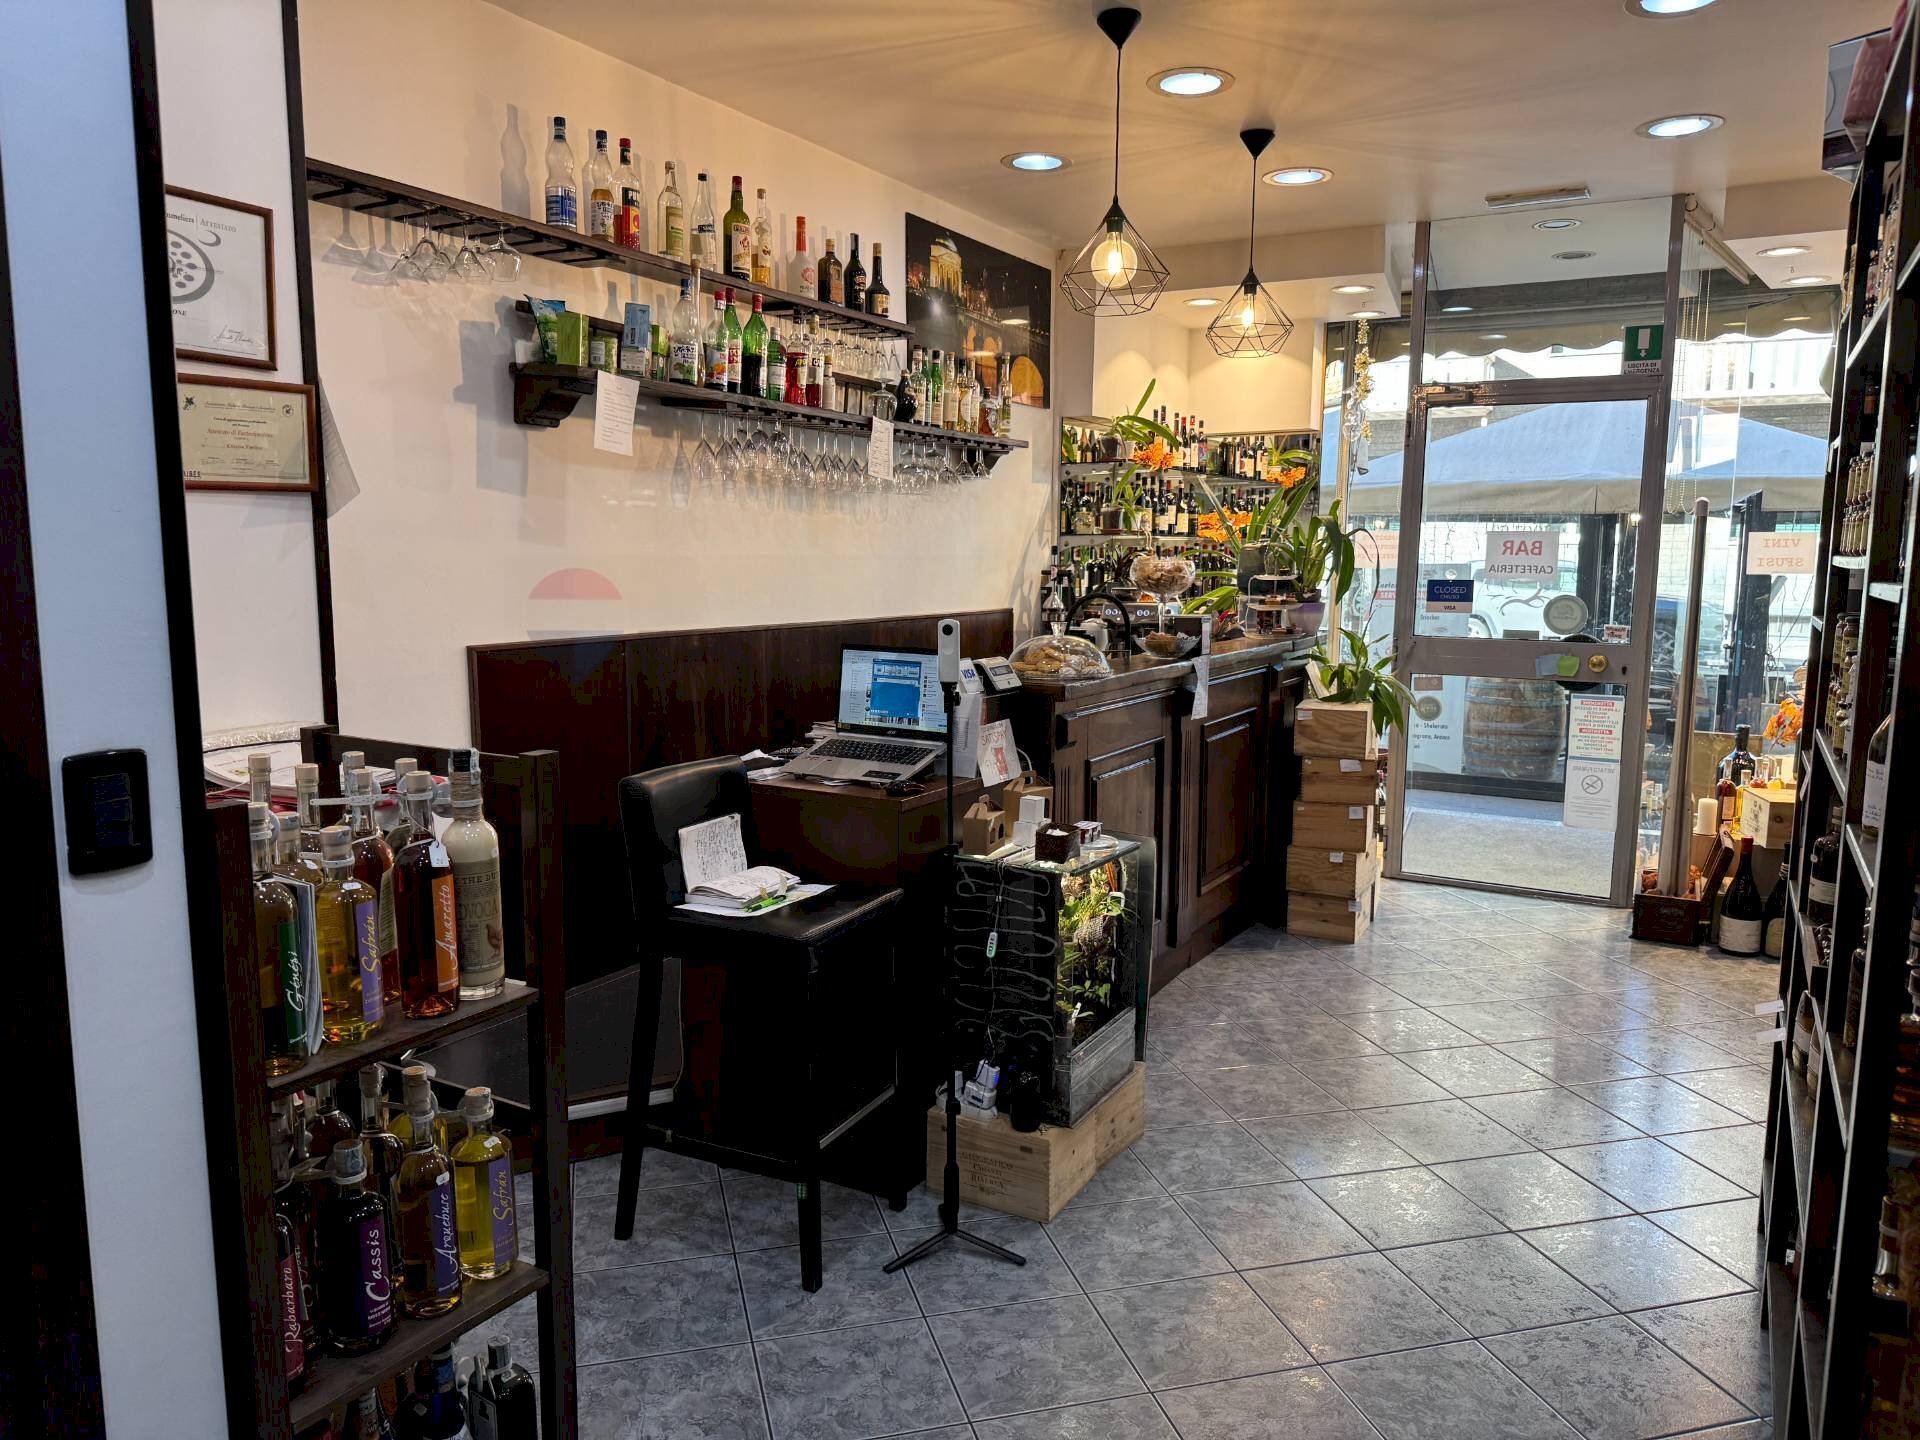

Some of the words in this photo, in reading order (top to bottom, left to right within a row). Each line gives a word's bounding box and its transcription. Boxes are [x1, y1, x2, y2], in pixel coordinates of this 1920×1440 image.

[1624, 367, 1660, 375] EMERGENZA
[1433, 586, 1467, 594] CLOSED
[961, 668, 977, 679] VISA
[463, 875, 482, 885] THE
[436, 883, 460, 971] Amaretto
[364, 1228, 391, 1303] Cassis
[281, 1266, 303, 1354] Rabarbaro
